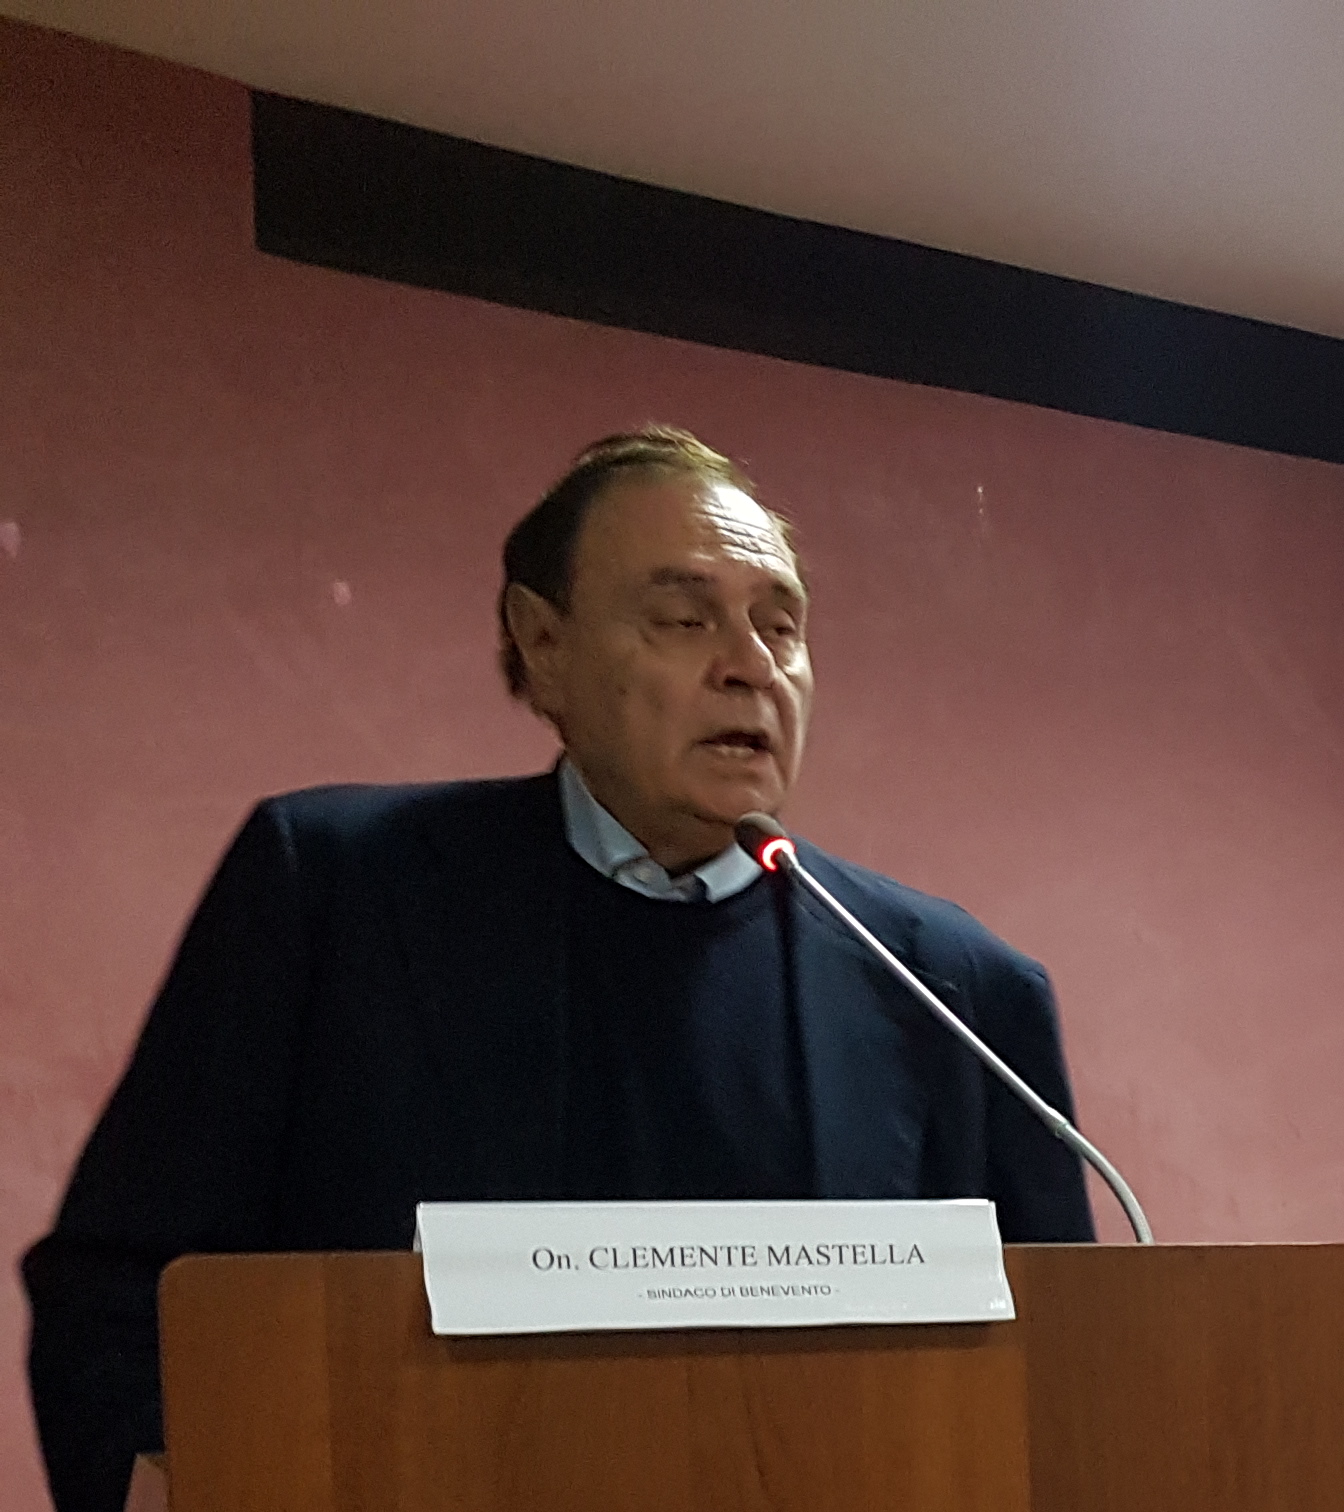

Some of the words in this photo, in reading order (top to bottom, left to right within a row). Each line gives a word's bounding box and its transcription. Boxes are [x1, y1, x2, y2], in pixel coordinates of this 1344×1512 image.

[532, 1246, 580, 1272] On.
[588, 1244, 759, 1271] CLEMENTE
[766, 1242, 927, 1268] MASTELLA
[646, 1287, 717, 1300] SINDACO
[721, 1286, 736, 1298] DI
[739, 1284, 833, 1298] BENEVENTO
